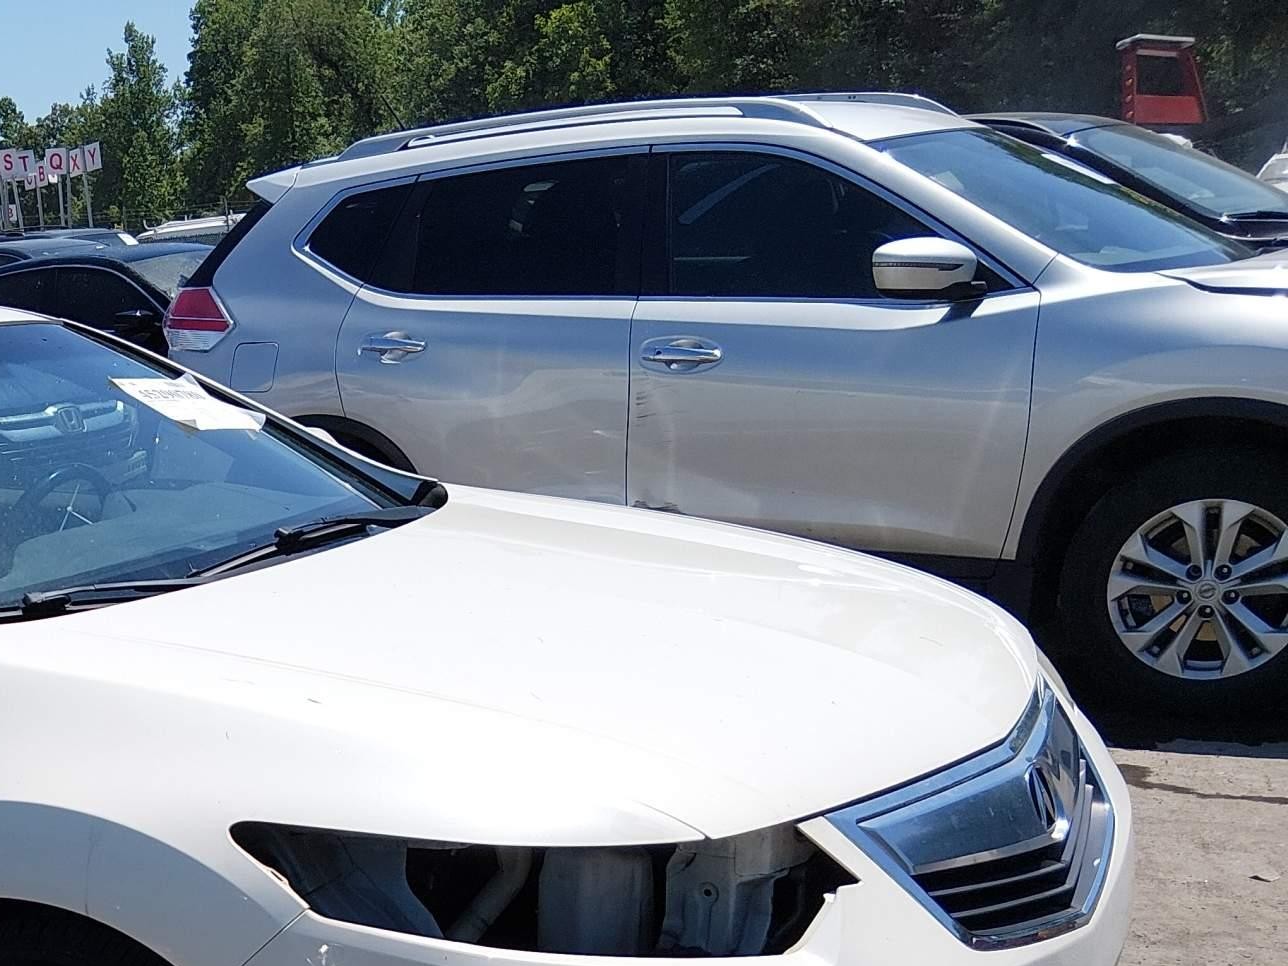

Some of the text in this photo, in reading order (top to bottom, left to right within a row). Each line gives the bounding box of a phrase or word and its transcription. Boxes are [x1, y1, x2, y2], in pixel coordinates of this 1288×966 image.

[4, 154, 13, 171] S
[18, 156, 29, 171] T
[50, 153, 63, 170] Q
[71, 154, 80, 171] X
[88, 148, 96, 165] Y
